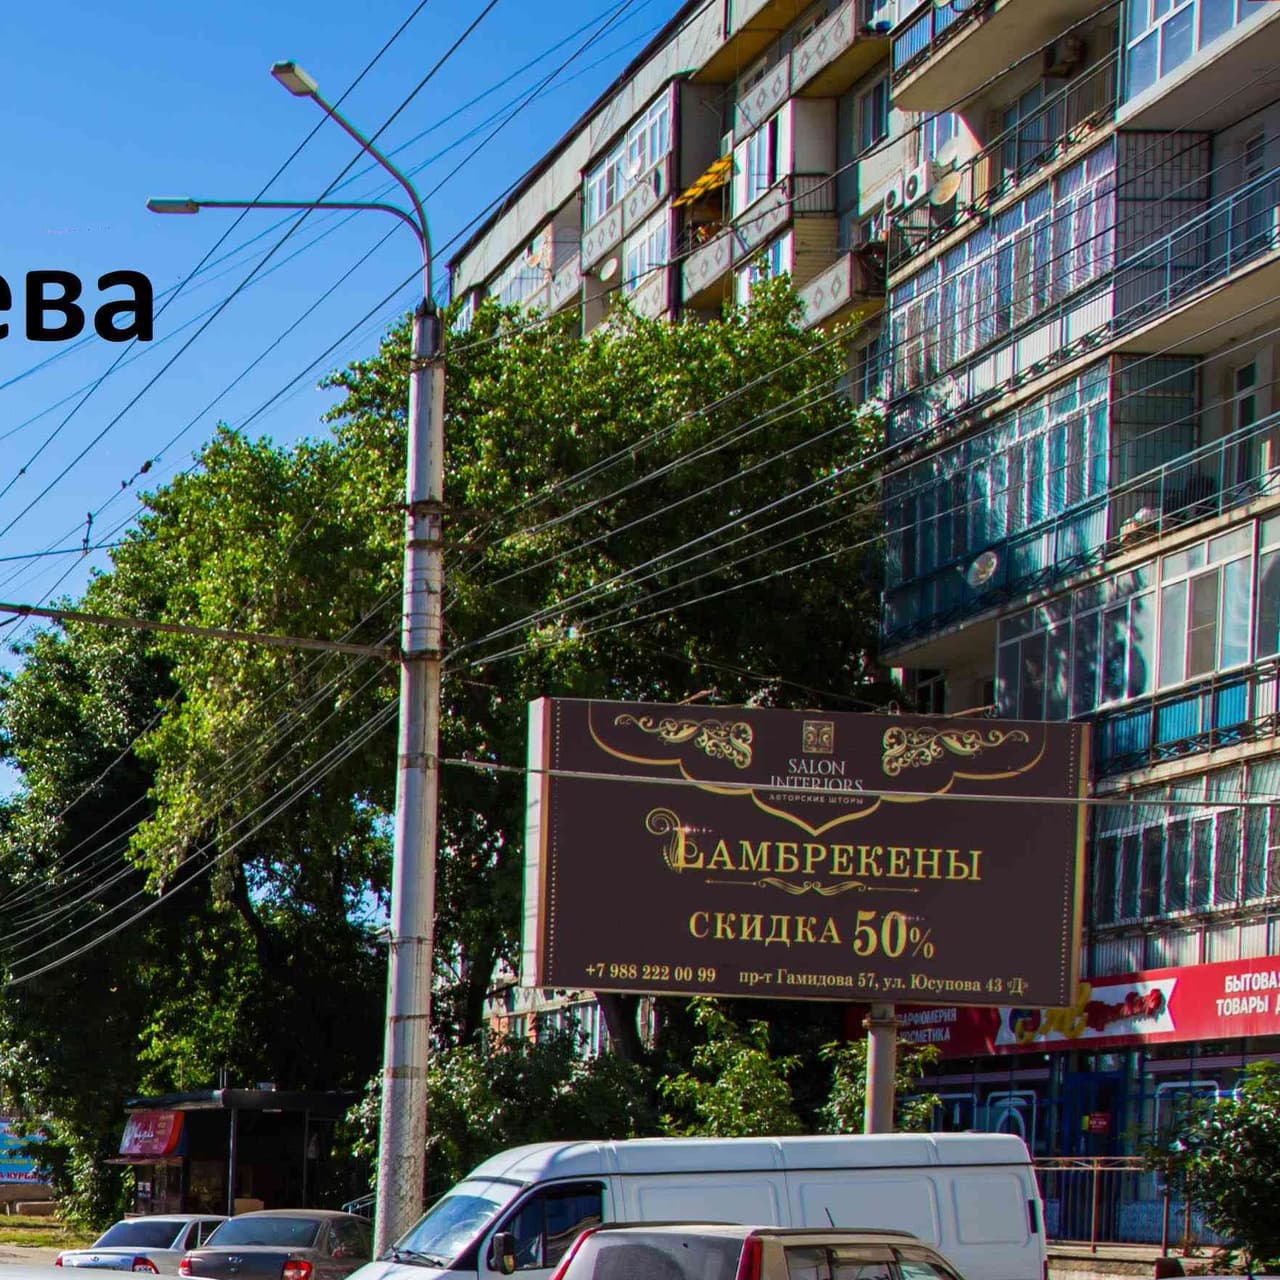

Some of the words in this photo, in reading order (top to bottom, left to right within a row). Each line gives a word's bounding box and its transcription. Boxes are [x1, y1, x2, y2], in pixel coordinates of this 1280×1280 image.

[787, 758, 846, 775] SALON
[770, 775, 865, 792] INTERIORS
[768, 793, 826, 804] АВТОРСКИЕ
[828, 795, 864, 805] ШТОРЫ
[688, 910, 843, 948] СКИДКА
[852, 909, 935, 960] 50%
[585, 963, 606, 978] +7
[609, 964, 639, 979] 988
[641, 965, 670, 981] 222
[673, 966, 694, 982] 00
[696, 967, 717, 983] 99
[739, 969, 772, 986] пр-т
[776, 968, 854, 988] Гамидова
[857, 973, 880, 990] 57,
[882, 977, 907, 991] ул.
[910, 973, 981, 993] Юсупова
[985, 978, 1003, 992] 43
[1215, 995, 1269, 1017] ТОВАРЫ
